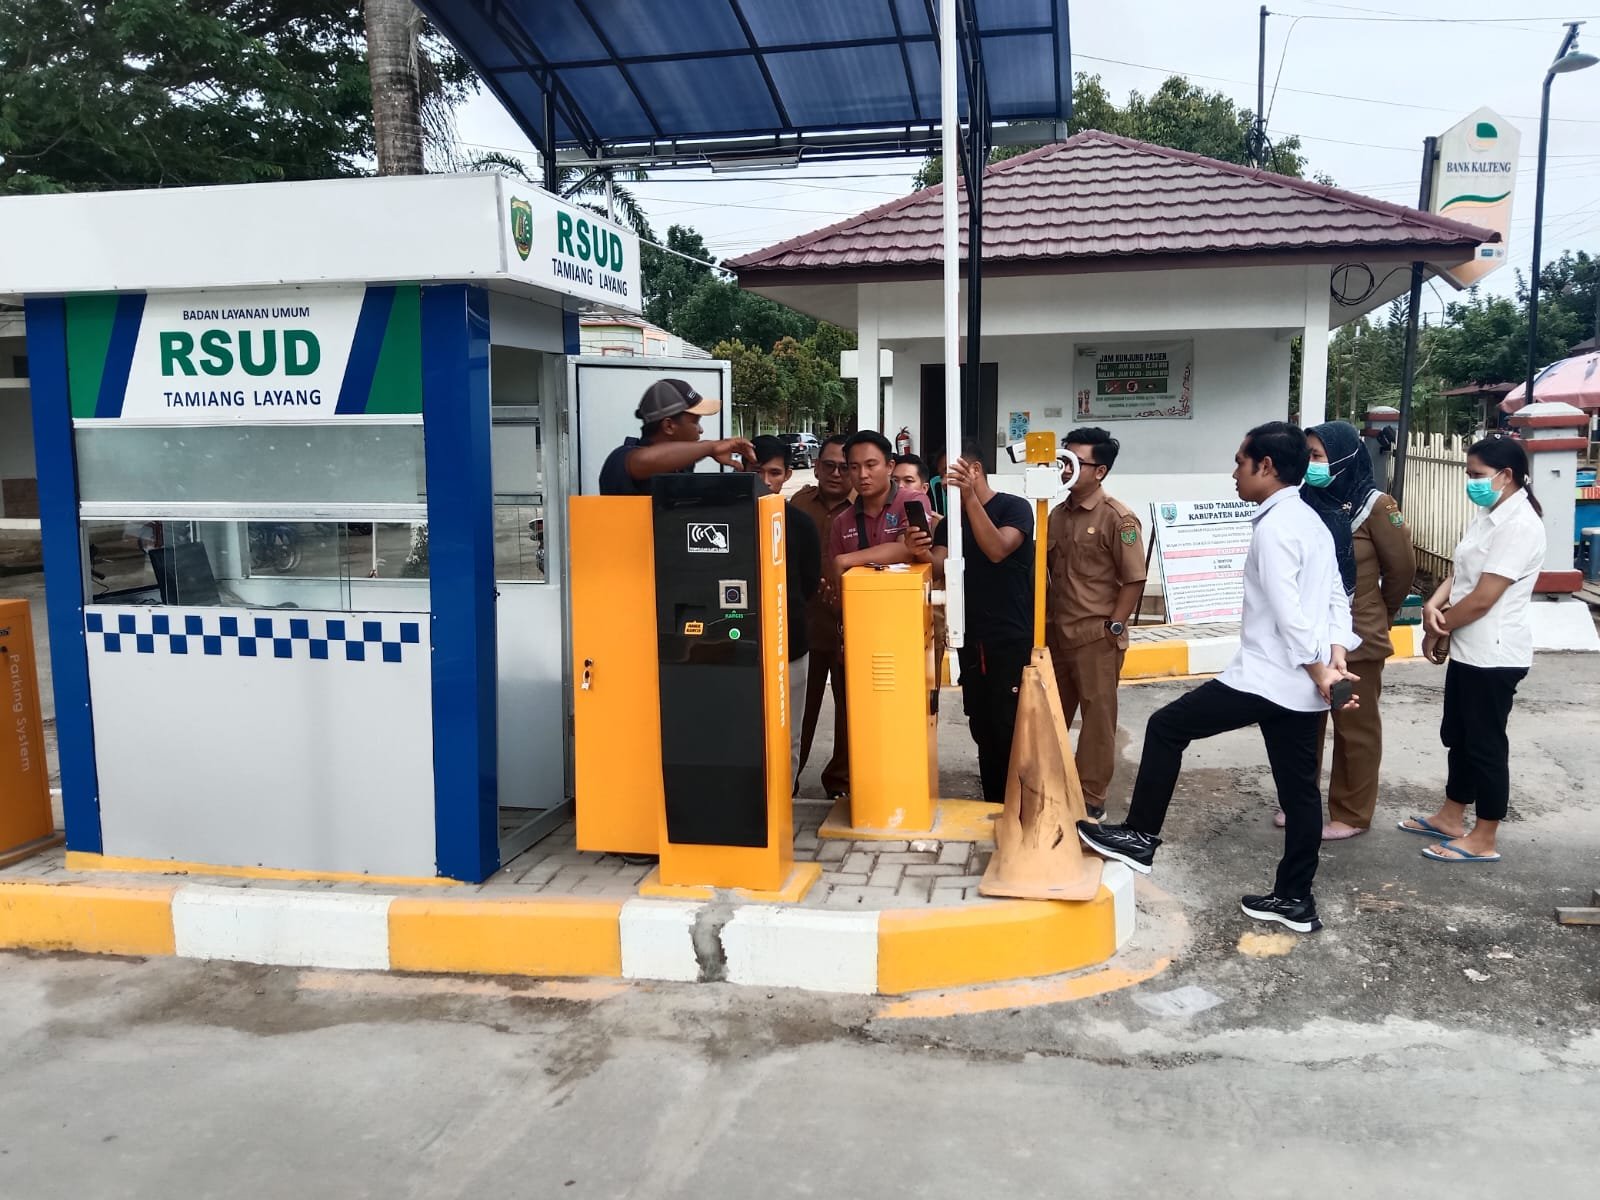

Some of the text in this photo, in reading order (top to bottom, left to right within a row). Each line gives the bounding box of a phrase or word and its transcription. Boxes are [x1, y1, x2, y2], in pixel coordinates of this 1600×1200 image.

[1446, 161, 1511, 173] BANK KALTENG
[557, 210, 623, 273] RSUD
[551, 258, 628, 297] TAMIANG LAYANG
[183, 307, 310, 321] BADAN LAYANAN UMUM
[159, 329, 321, 376] RSUD
[1100, 354, 1114, 363] JAM
[163, 389, 321, 407] TAMIANG LAYANG
[1193, 503, 1214, 511] RSUD
[1215, 501, 1250, 510] TAMIANG
[1188, 511, 1233, 521] KABUPATEN
[778, 659, 786, 729] System
[9, 654, 31, 772] Parking System
